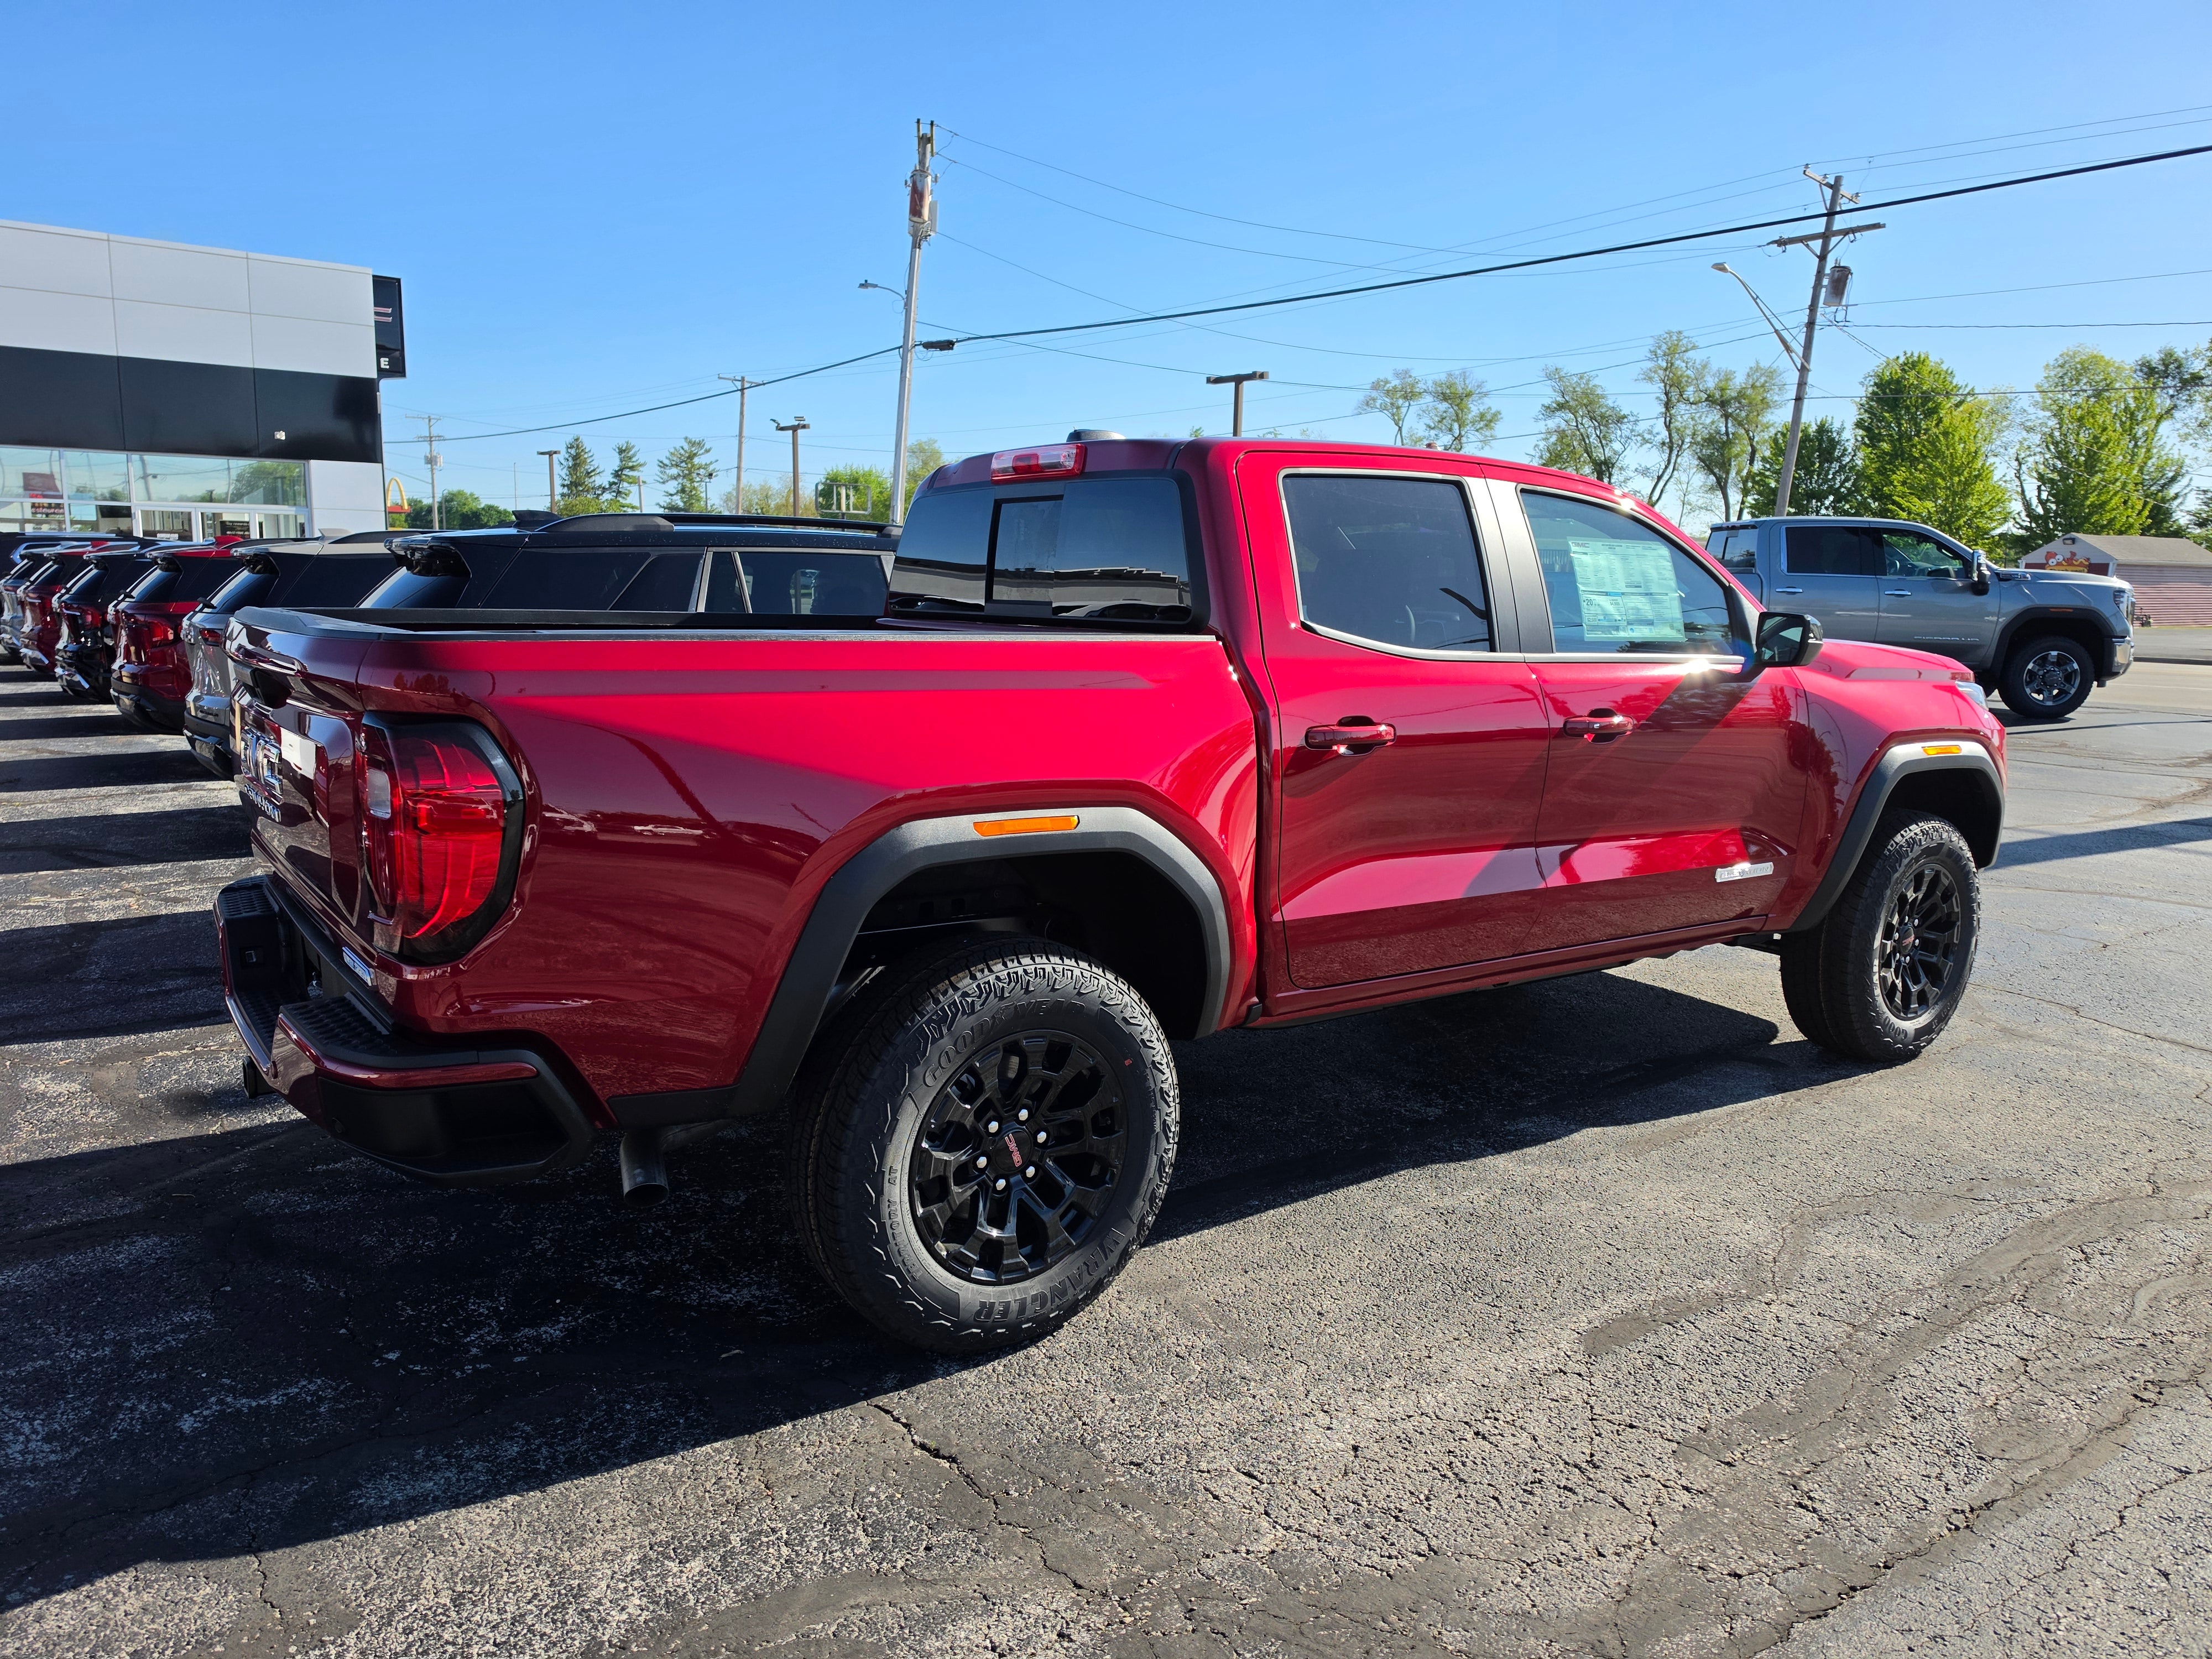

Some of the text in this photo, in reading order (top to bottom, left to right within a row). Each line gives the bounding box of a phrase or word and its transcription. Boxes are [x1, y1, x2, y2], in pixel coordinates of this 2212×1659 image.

[1005, 1133, 1022, 1167] GMC
[888, 1165, 923, 1281] TERRITORY AT
[973, 1227, 1126, 1323] WRANGLER
